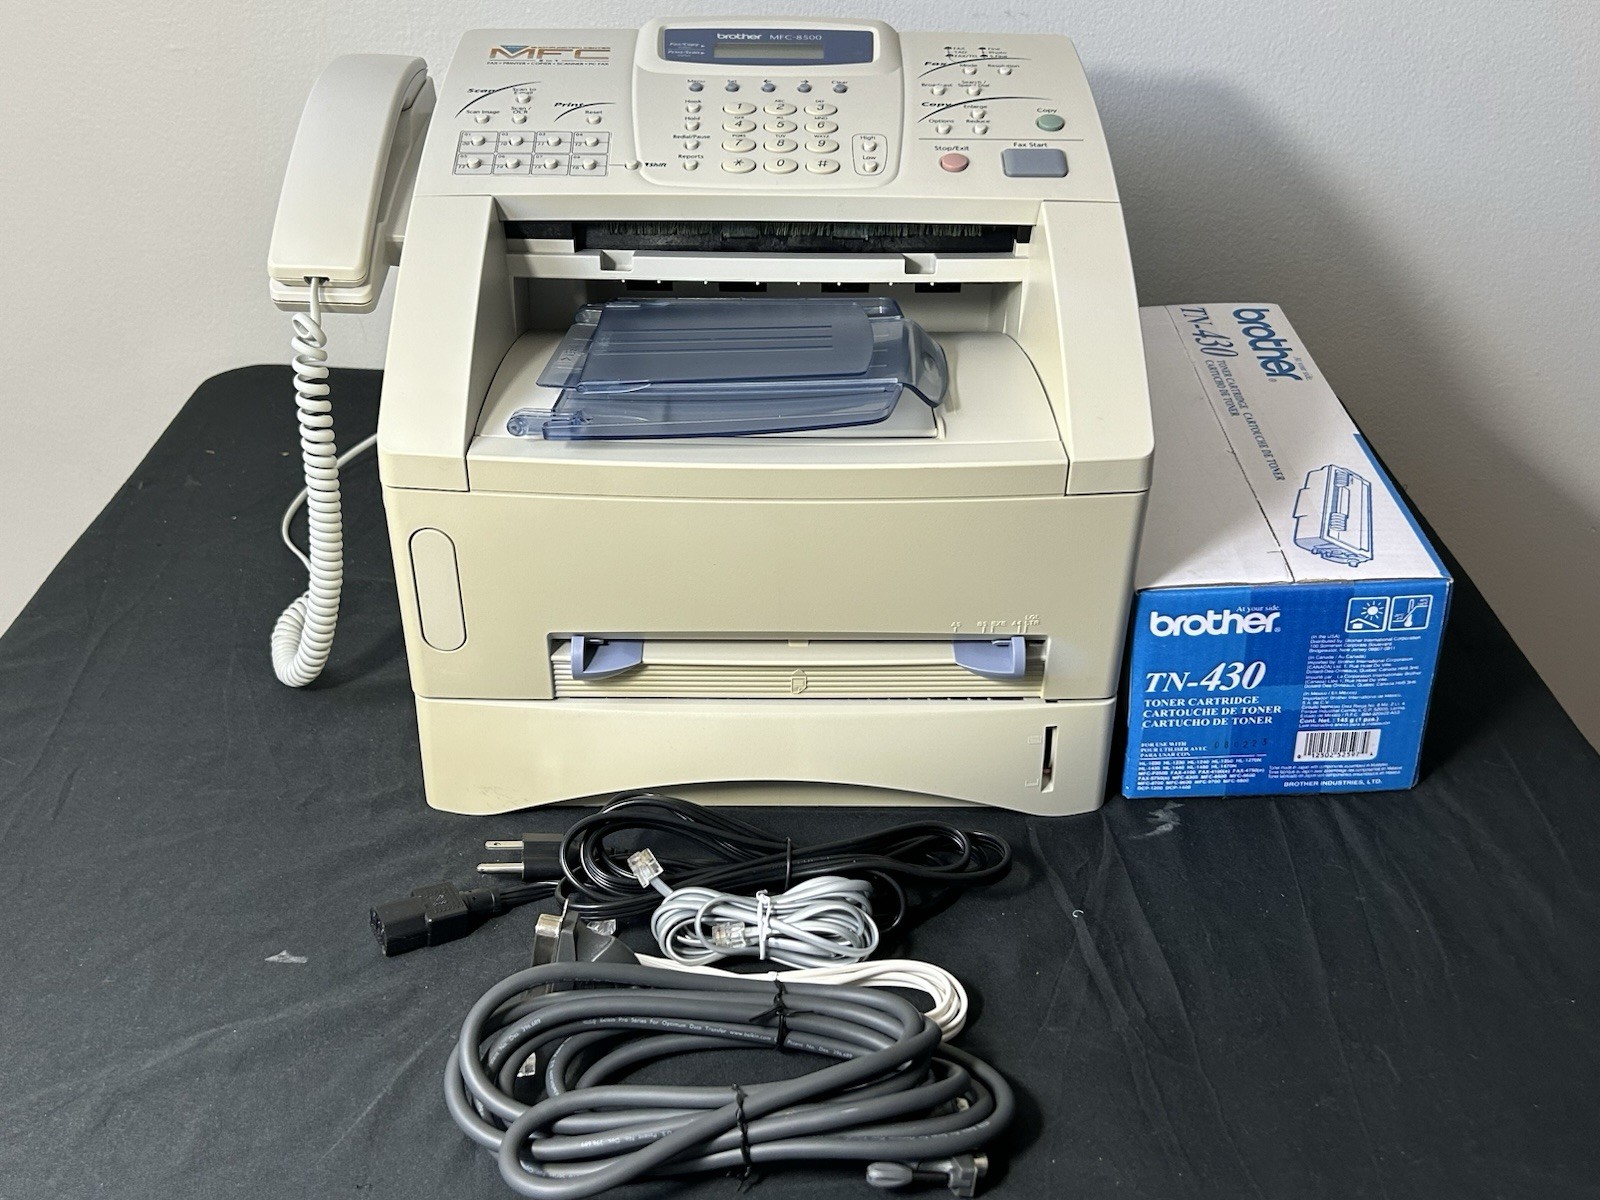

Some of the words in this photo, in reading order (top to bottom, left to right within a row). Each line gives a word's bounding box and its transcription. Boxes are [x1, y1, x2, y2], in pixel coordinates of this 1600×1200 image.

[489, 47, 611, 60] MFC
[777, 159, 785, 167] 0
[1180, 307, 1239, 357] TN-430
[1232, 308, 1303, 381] brother
[1205, 359, 1226, 389] CARTUCHO
[1216, 359, 1232, 377] TONER
[1218, 388, 1231, 397] DE
[1225, 377, 1249, 409] CARTRIDGE
[1222, 397, 1240, 417] TONER
[1242, 412, 1269, 448] CARTOUCHE
[1261, 448, 1274, 458] DE
[1266, 459, 1286, 481] TONER
[1246, 605, 1264, 614] your
[1149, 609, 1281, 637] brother
[1144, 660, 1267, 693] TN-430
[1144, 698, 1186, 708] TONER
[1187, 695, 1260, 706] CARTRIDGE
[1142, 707, 1219, 718] CARTOUCHE
[1221, 707, 1238, 716] DE
[1240, 705, 1282, 715] TONER
[1141, 717, 1210, 729] CARTUCHO
[1212, 717, 1229, 726] DE
[1231, 716, 1273, 725] TONER
[661, 1020, 687, 1028] Optimum
